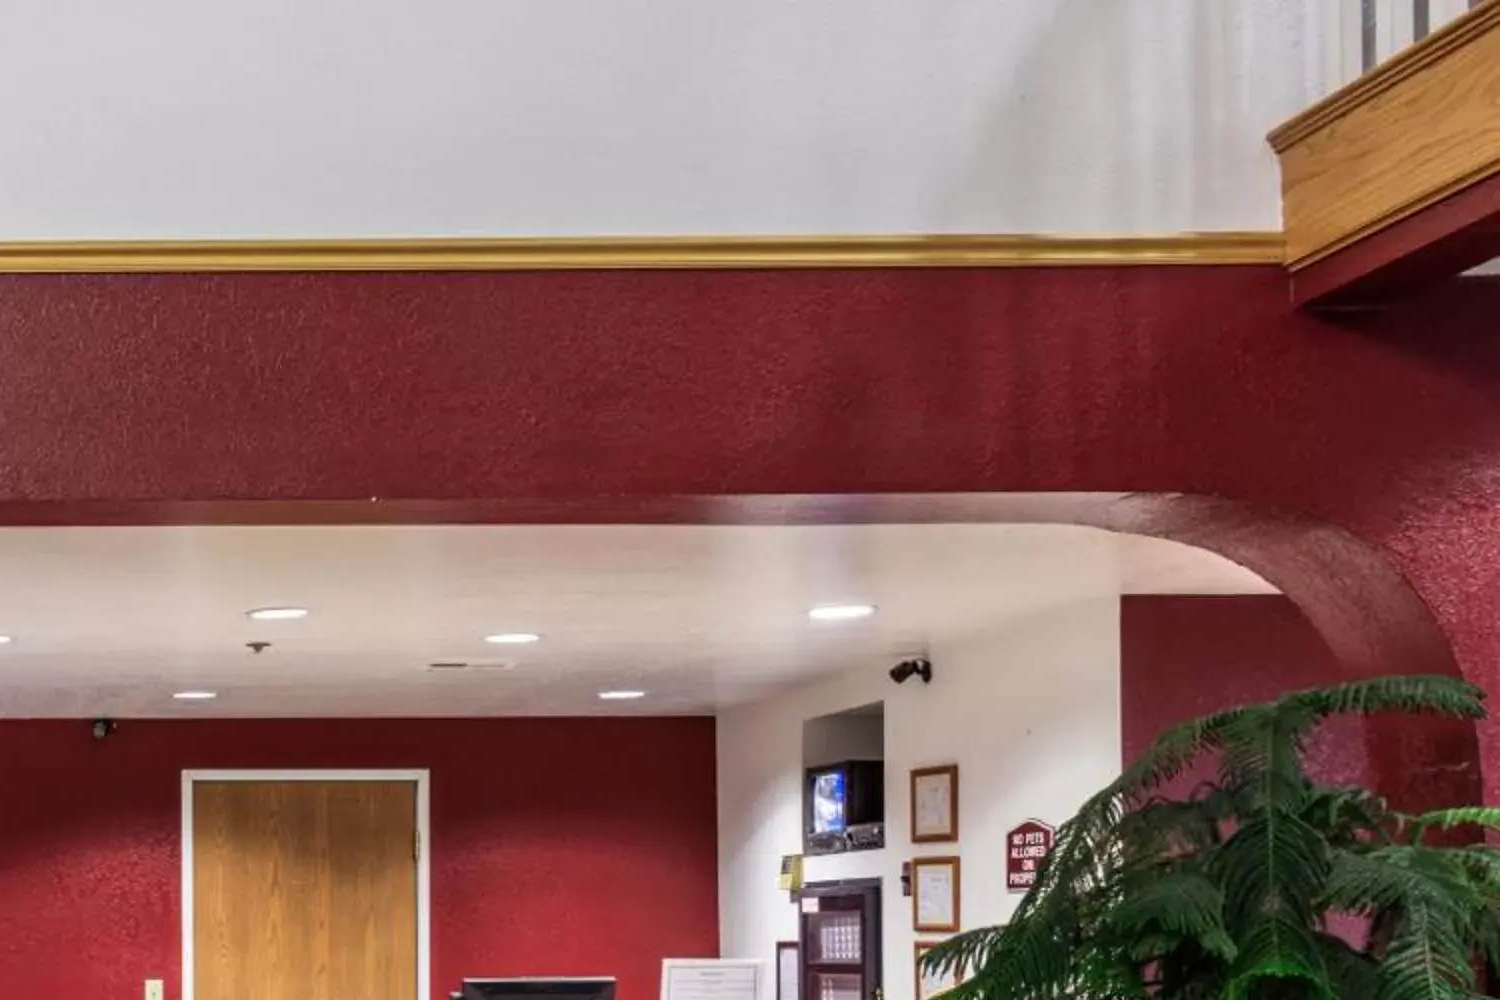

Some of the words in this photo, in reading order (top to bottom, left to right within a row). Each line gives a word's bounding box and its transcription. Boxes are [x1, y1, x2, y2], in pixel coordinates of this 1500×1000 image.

[1012, 833, 1024, 845] NO
[1025, 832, 1045, 845] PETS
[1011, 846, 1046, 859] ALLOWED
